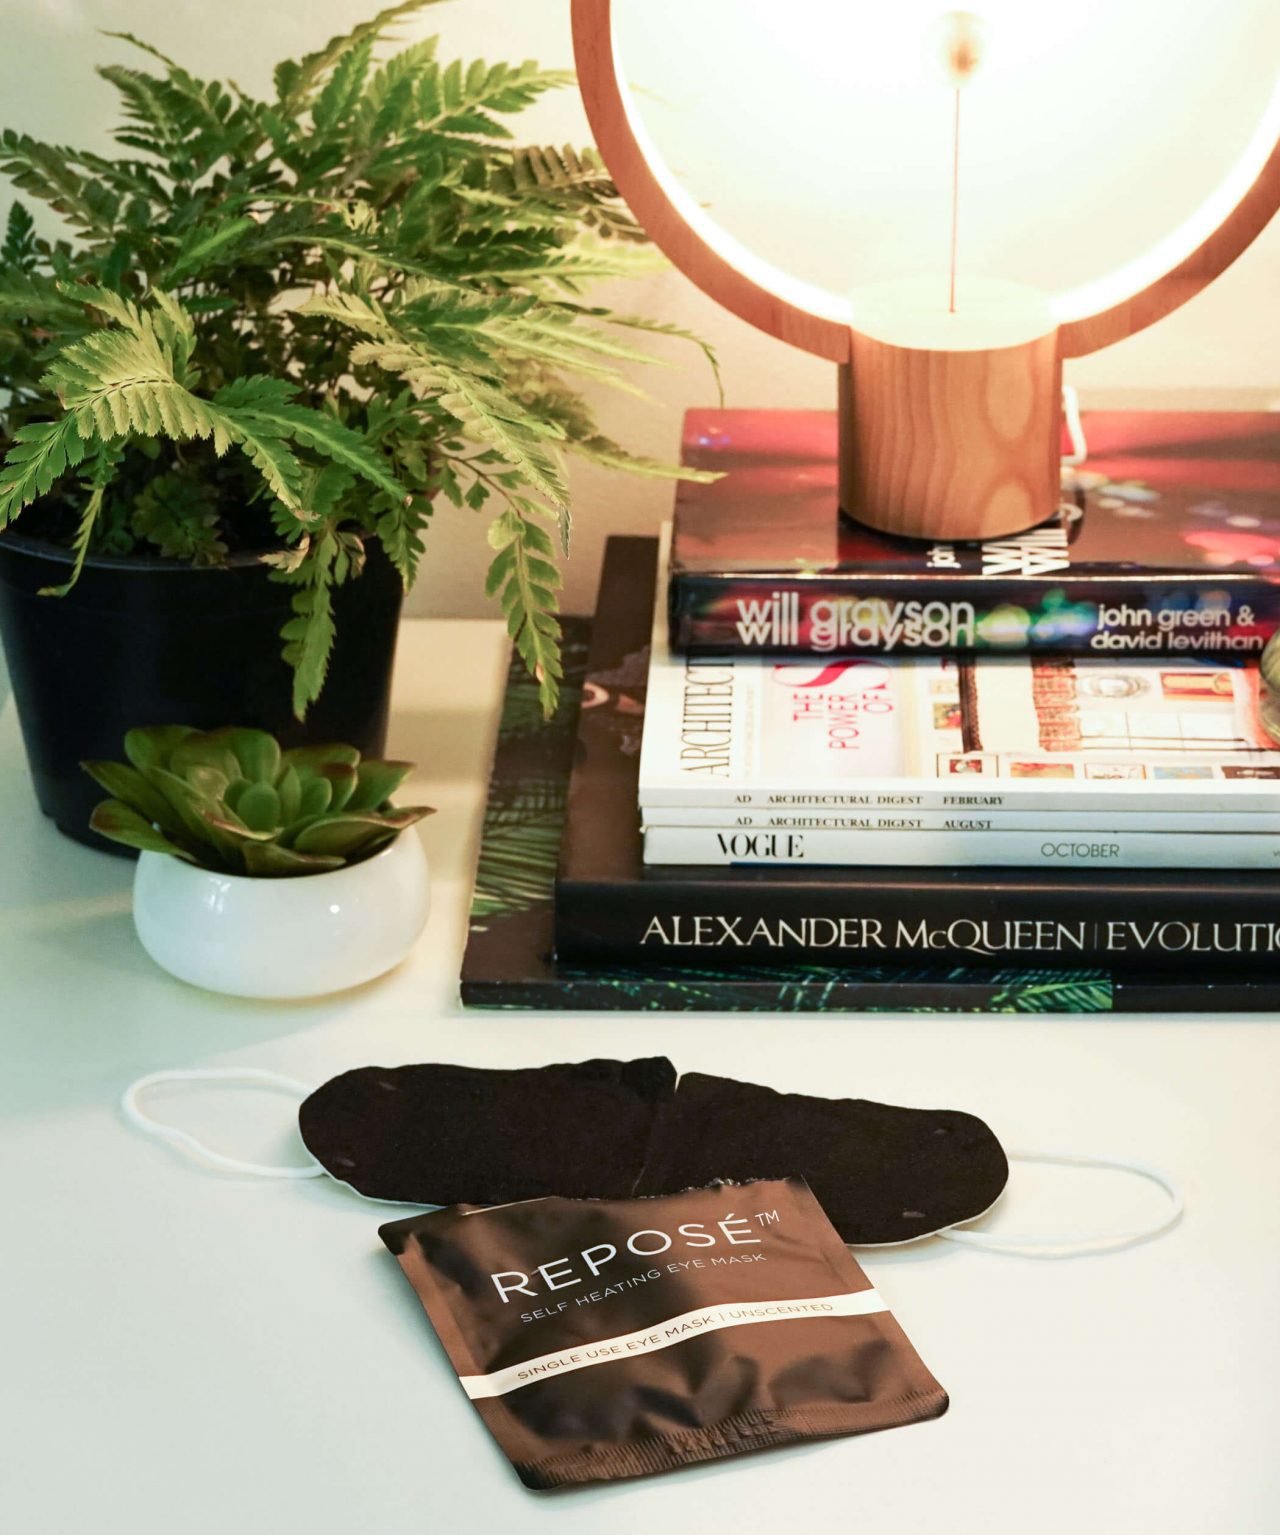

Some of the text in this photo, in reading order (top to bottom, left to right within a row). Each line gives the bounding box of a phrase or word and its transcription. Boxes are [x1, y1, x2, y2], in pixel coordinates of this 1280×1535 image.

[1097, 604, 1255, 632] john green &
[1090, 630, 1264, 650] david levithan
[793, 693, 825, 722] THE
[862, 693, 894, 714] OF
[828, 689, 861, 750] POWER
[734, 794, 1005, 806] AD ARCHITECTURAL DIGEST FEBRUARY
[735, 816, 993, 830] AD ARCHITECTURAL DIGEST AUGUST
[716, 832, 805, 858] VOGUE
[1040, 842, 1121, 858] OCTOBER
[639, 915, 887, 948] ALEXANDER
[895, 918, 1086, 956] McQUEEN
[520, 1252, 767, 1323] SELF HEATING EYE MASK
[517, 1354, 580, 1381] SINGLE
[586, 1345, 621, 1360] USE
[626, 1334, 662, 1352] EYE
[664, 1315, 716, 1339] MASK
[729, 1302, 834, 1319] UNSCENTED
